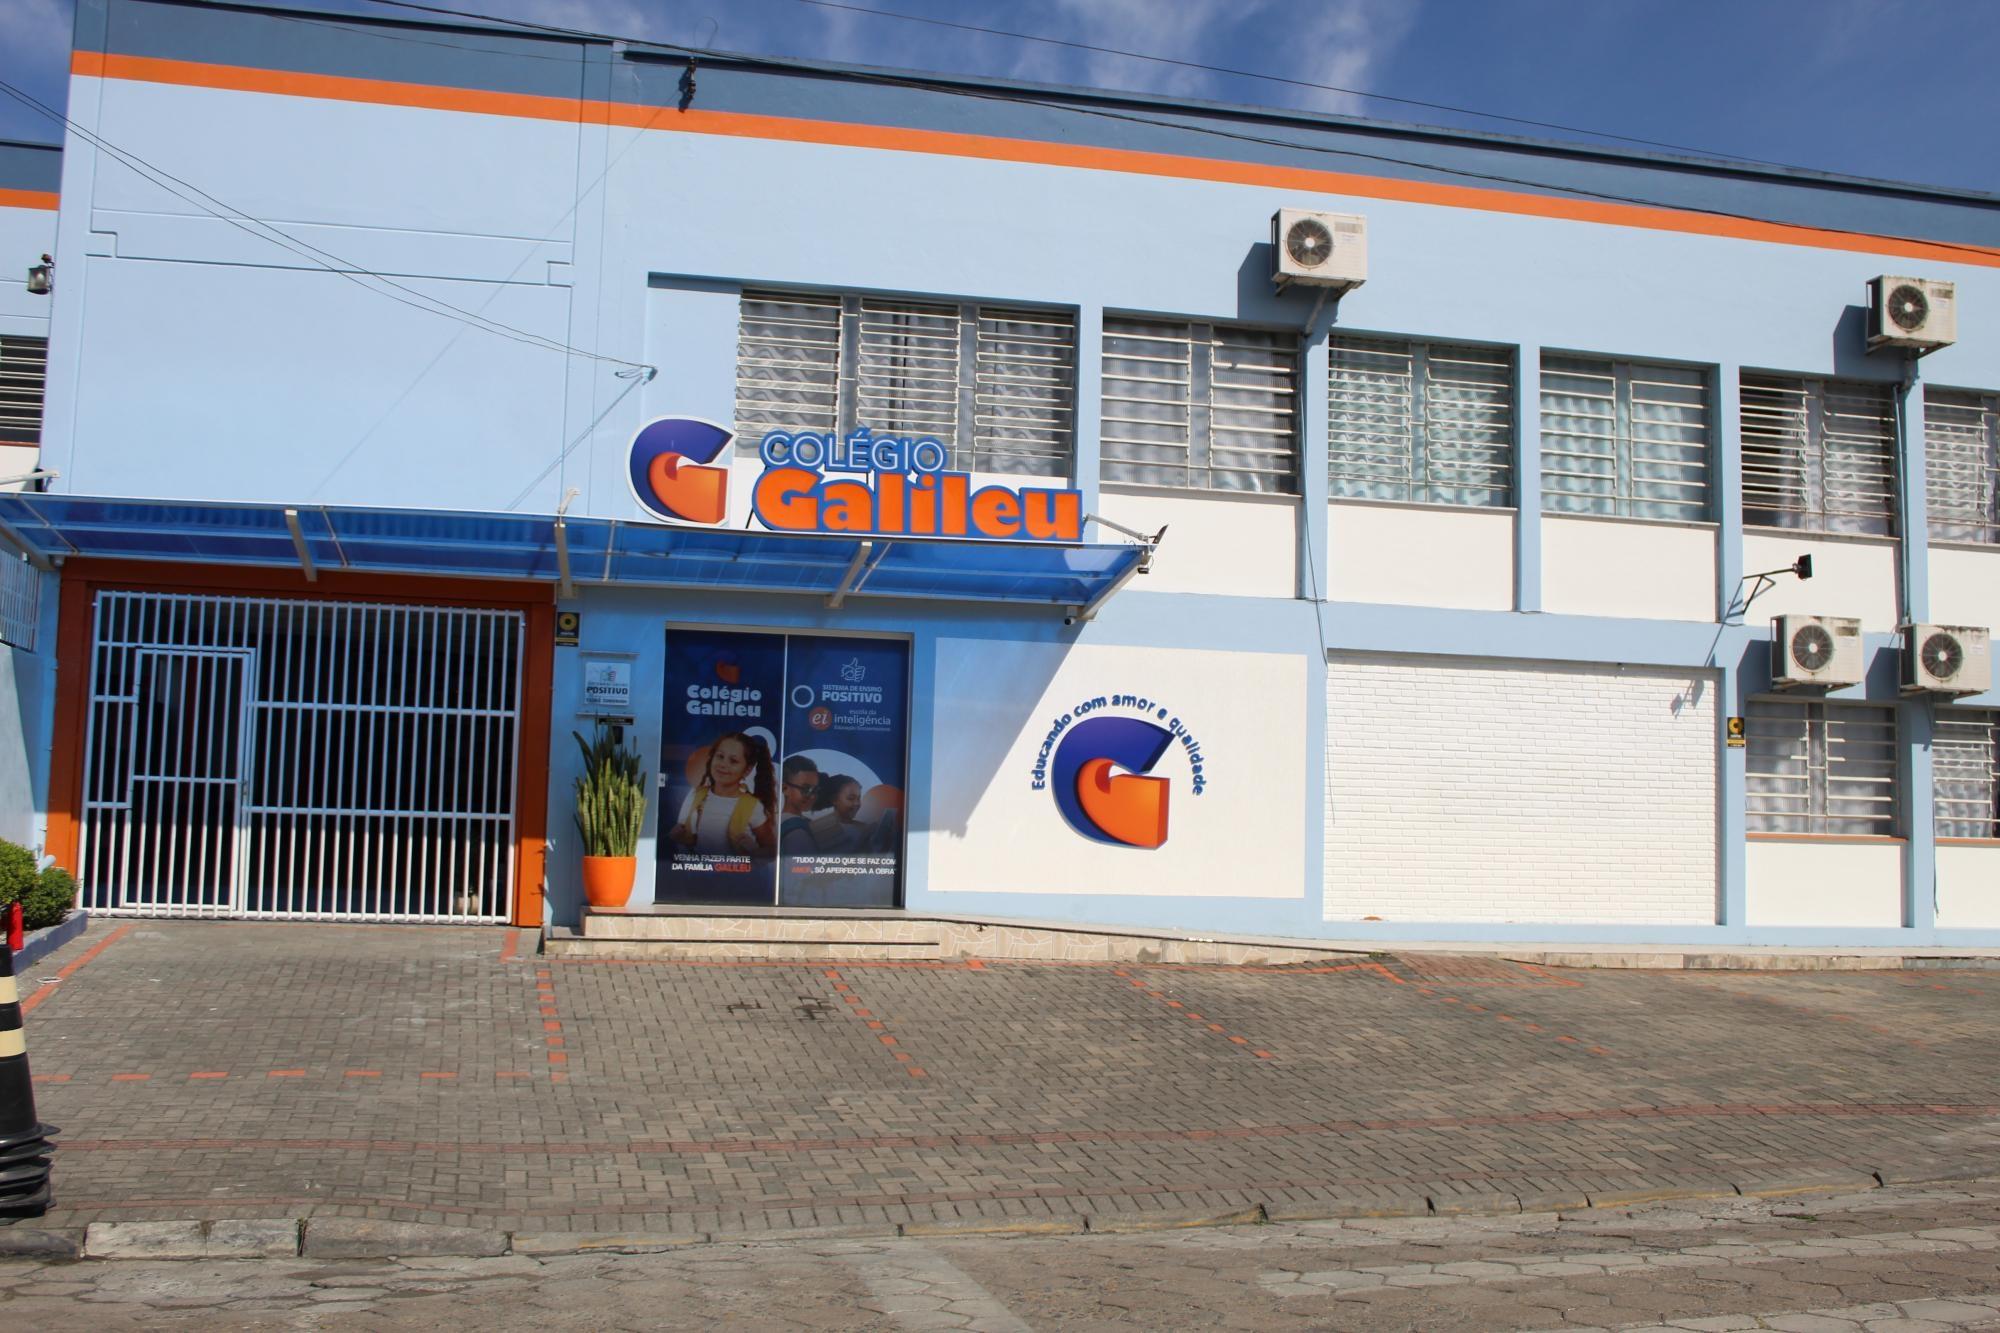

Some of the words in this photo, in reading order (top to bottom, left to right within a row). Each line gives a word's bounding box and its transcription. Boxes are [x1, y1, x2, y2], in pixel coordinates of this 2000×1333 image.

[763, 428, 944, 472] COLÉGIO
[755, 468, 1080, 540] Galileu
[586, 686, 628, 695] POSITIVO
[687, 684, 762, 702] Colégio
[822, 691, 882, 703] POSITIVO
[686, 700, 761, 717] Galileu
[834, 714, 891, 727] inteligência
[1031, 713, 1072, 791] Educando
[1074, 695, 1107, 718] com
[1111, 694, 1156, 713] amor
[1156, 708, 1168, 720] e
[1169, 717, 1207, 796] qualidade
[674, 853, 700, 861] VENHA
[701, 854, 725, 862] FAZER
[726, 855, 751, 863] PARTE
[816, 857, 841, 865] AQUILO
[842, 858, 856, 866] QUE
[684, 863, 713, 871] FAMÍLIA
[814, 866, 825, 874] SÓ
[826, 867, 867, 875] APERFEIÇOA
